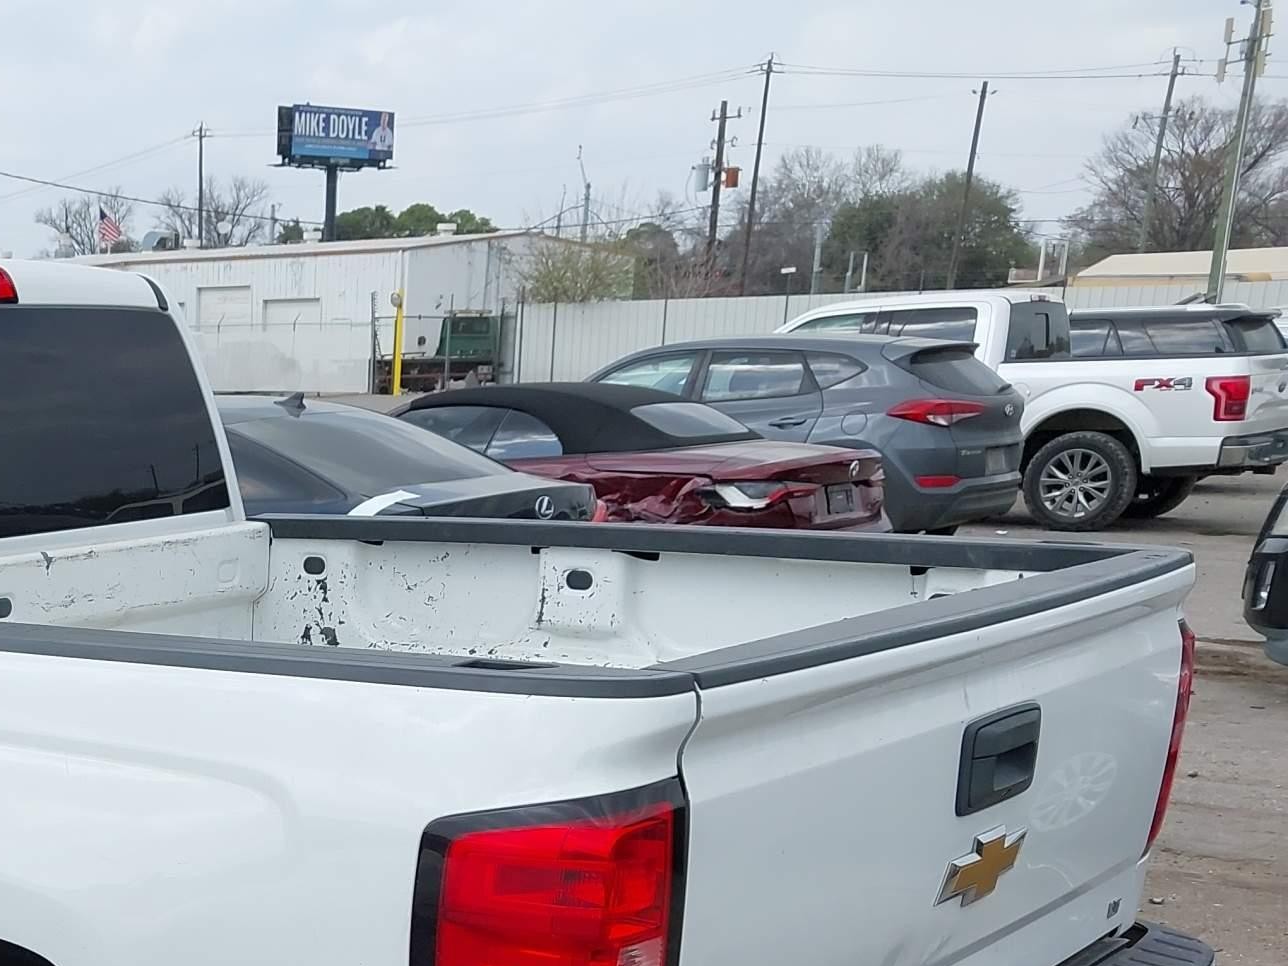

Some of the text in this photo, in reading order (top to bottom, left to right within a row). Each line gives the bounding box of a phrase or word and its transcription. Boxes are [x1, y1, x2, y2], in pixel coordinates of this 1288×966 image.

[294, 111, 369, 140] MIKE DOYLE
[1134, 377, 1193, 391] FX4
